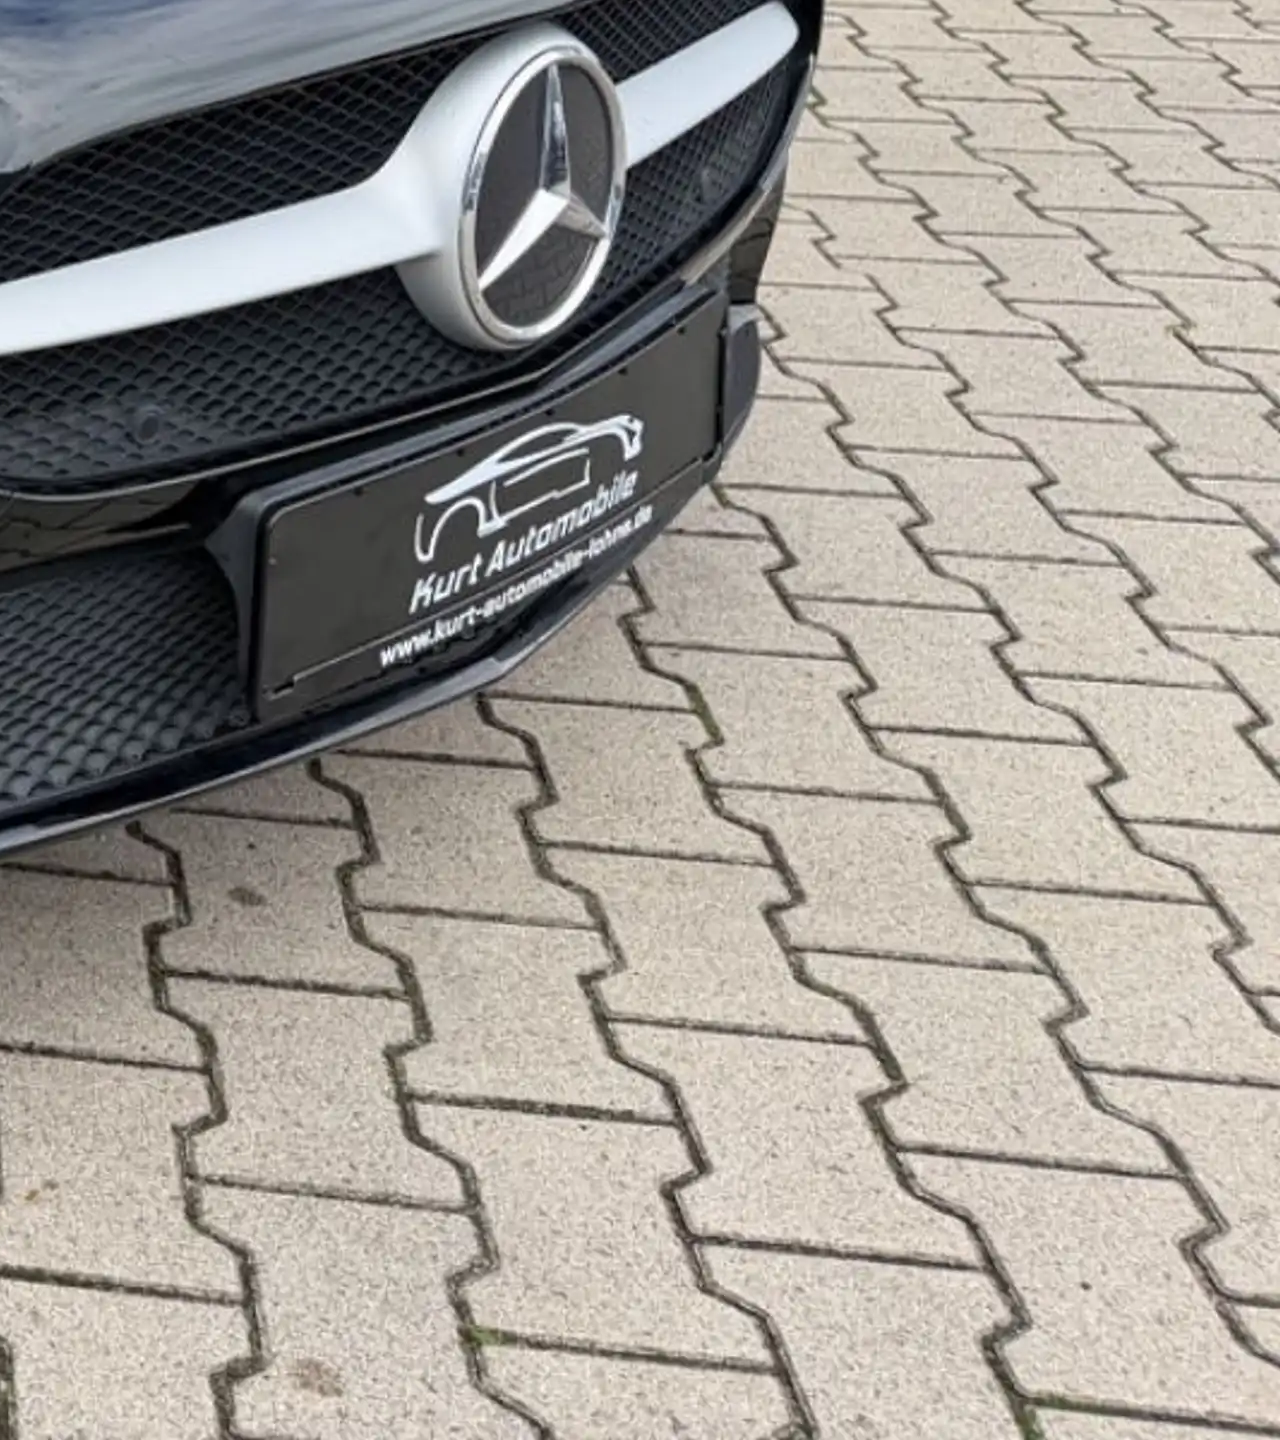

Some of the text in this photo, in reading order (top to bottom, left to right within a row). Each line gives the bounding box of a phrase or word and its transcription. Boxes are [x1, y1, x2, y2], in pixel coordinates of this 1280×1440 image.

[380, 505, 653, 667] www.kurt-automobile-lohne.de
[409, 470, 639, 615] Kurt Automobile
